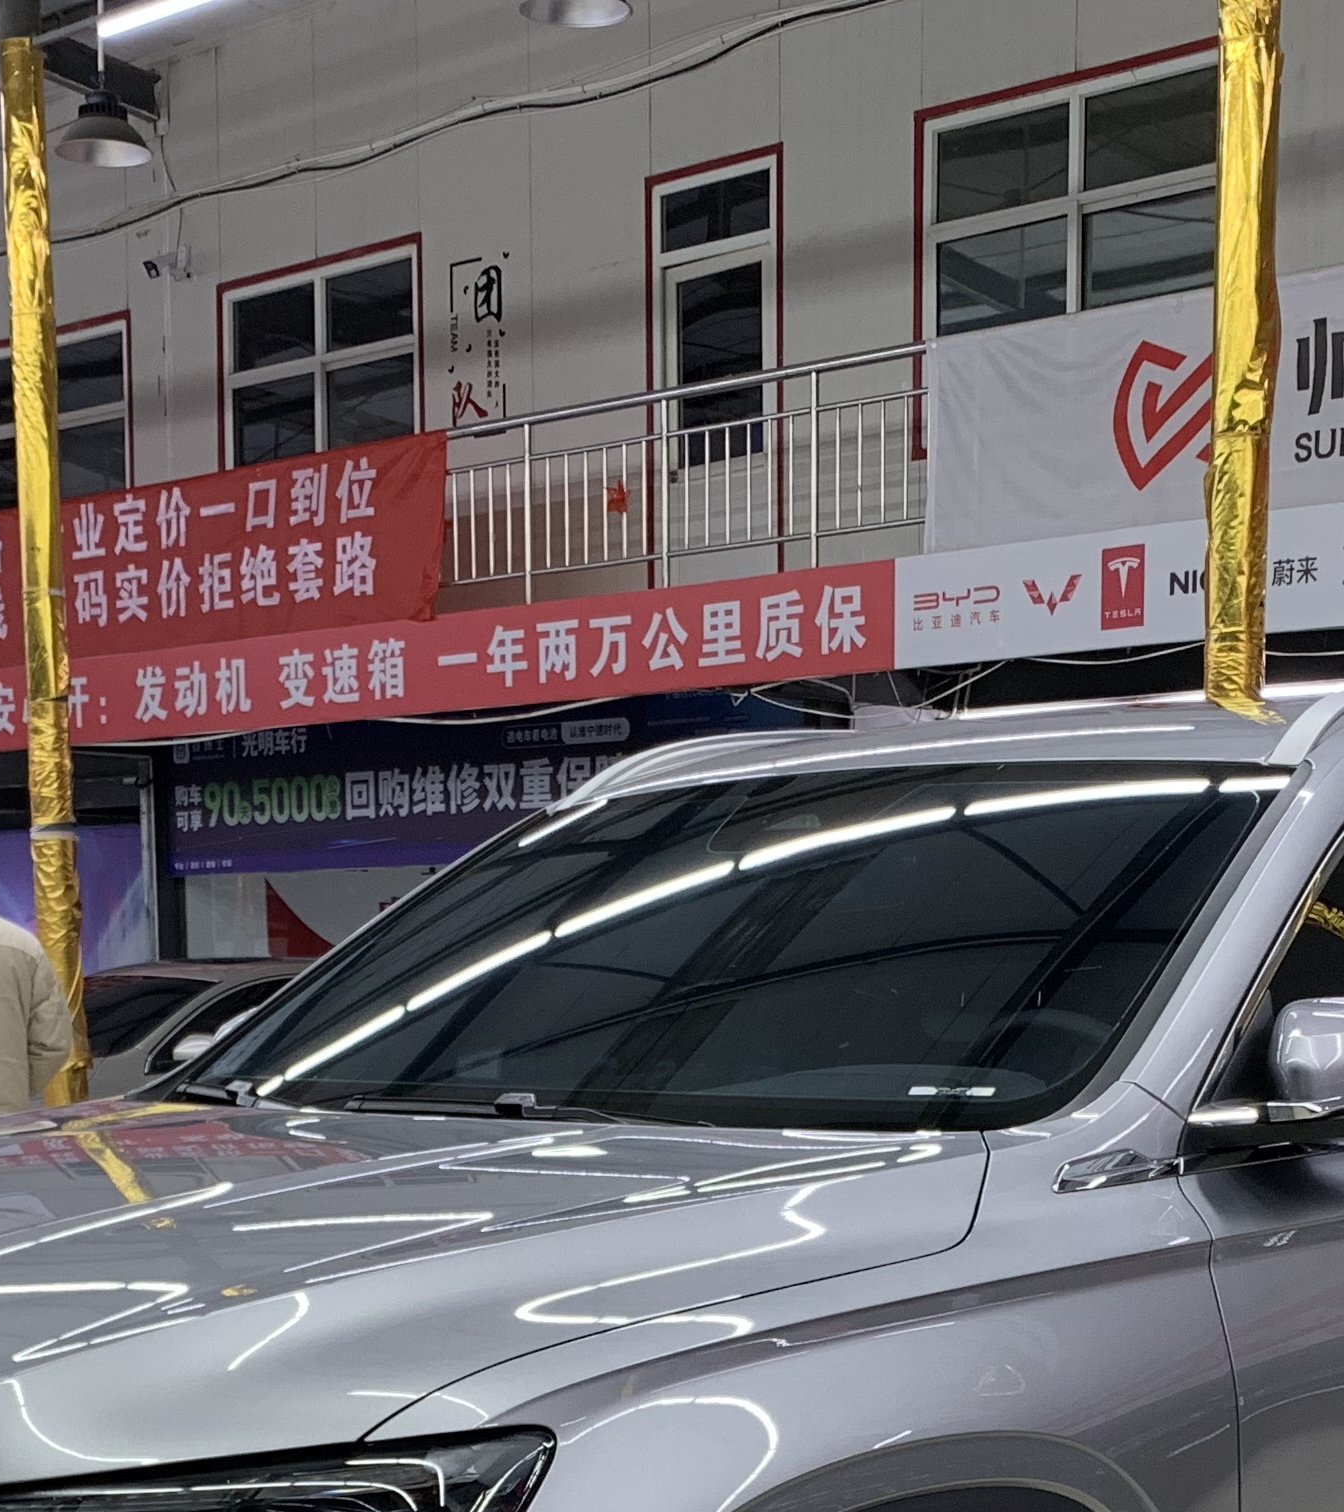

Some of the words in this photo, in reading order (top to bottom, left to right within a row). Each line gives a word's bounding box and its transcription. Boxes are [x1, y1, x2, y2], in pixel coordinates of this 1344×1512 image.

[60, 457, 378, 561] 业定价一口到位
[1169, 571, 1206, 597] NI
[1271, 556, 1319, 587] 蔚来
[913, 585, 1001, 611] BYD
[912, 609, 1001, 632] 比亚迪汽车
[1103, 607, 1143, 620] TESLA
[278, 637, 406, 710] 变速箱
[437, 585, 867, 687] 一年两万公里质保
[242, 727, 308, 758] 光明车行
[174, 784, 203, 807] 购车
